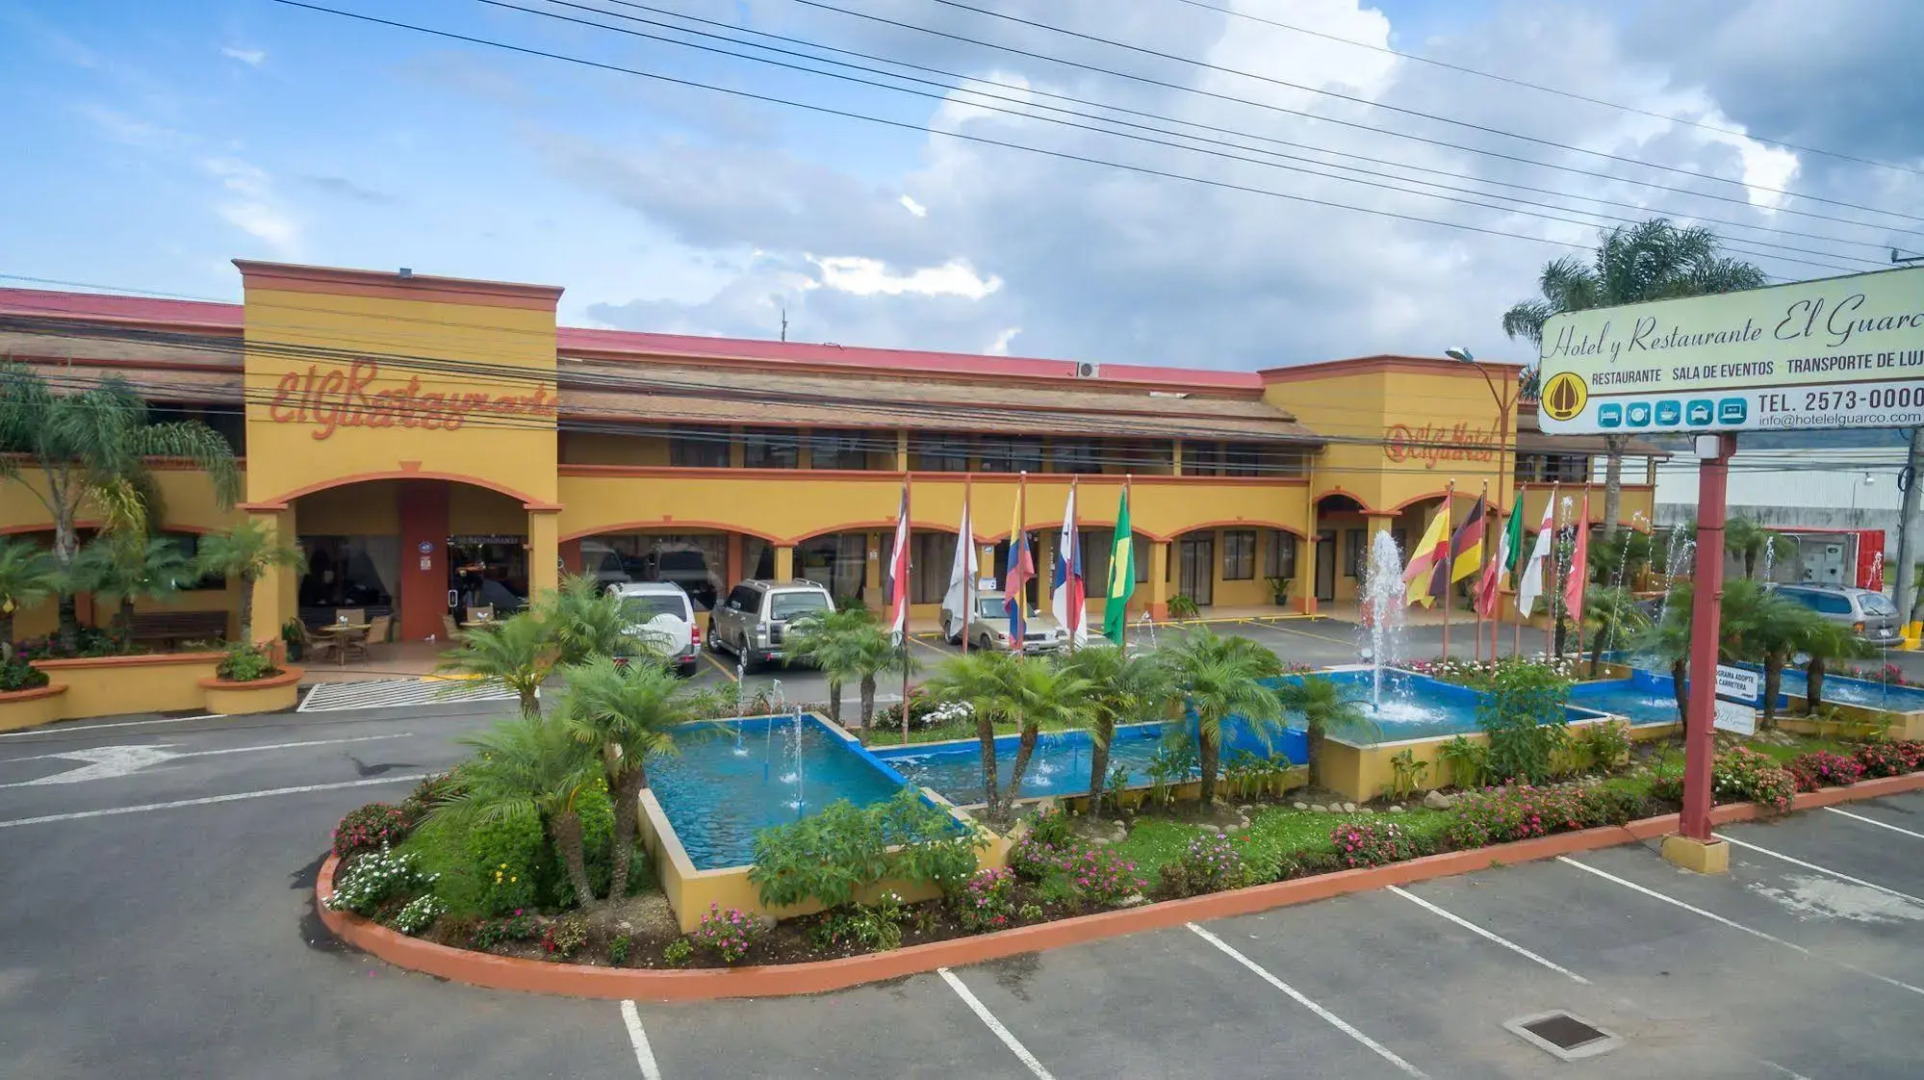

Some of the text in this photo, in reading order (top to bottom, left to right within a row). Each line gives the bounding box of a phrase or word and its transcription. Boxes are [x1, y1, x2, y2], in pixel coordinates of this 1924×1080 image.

[1541, 320, 1611, 359] Hotel
[1610, 340, 1621, 363] y
[1628, 316, 1762, 352] Restaurante
[1774, 297, 1825, 341] El
[1592, 369, 1662, 386] RESTAURANTE
[1672, 366, 1700, 381] SALA
[1703, 365, 1717, 379] DE
[1720, 361, 1774, 378] EVENTOS
[1787, 353, 1873, 374] TRANSPORTE
[1877, 352, 1895, 368] DE
[1758, 387, 1924, 413] TEL. 2573-0000
[1759, 412, 1921, 428] info@hotelelguarco.com
